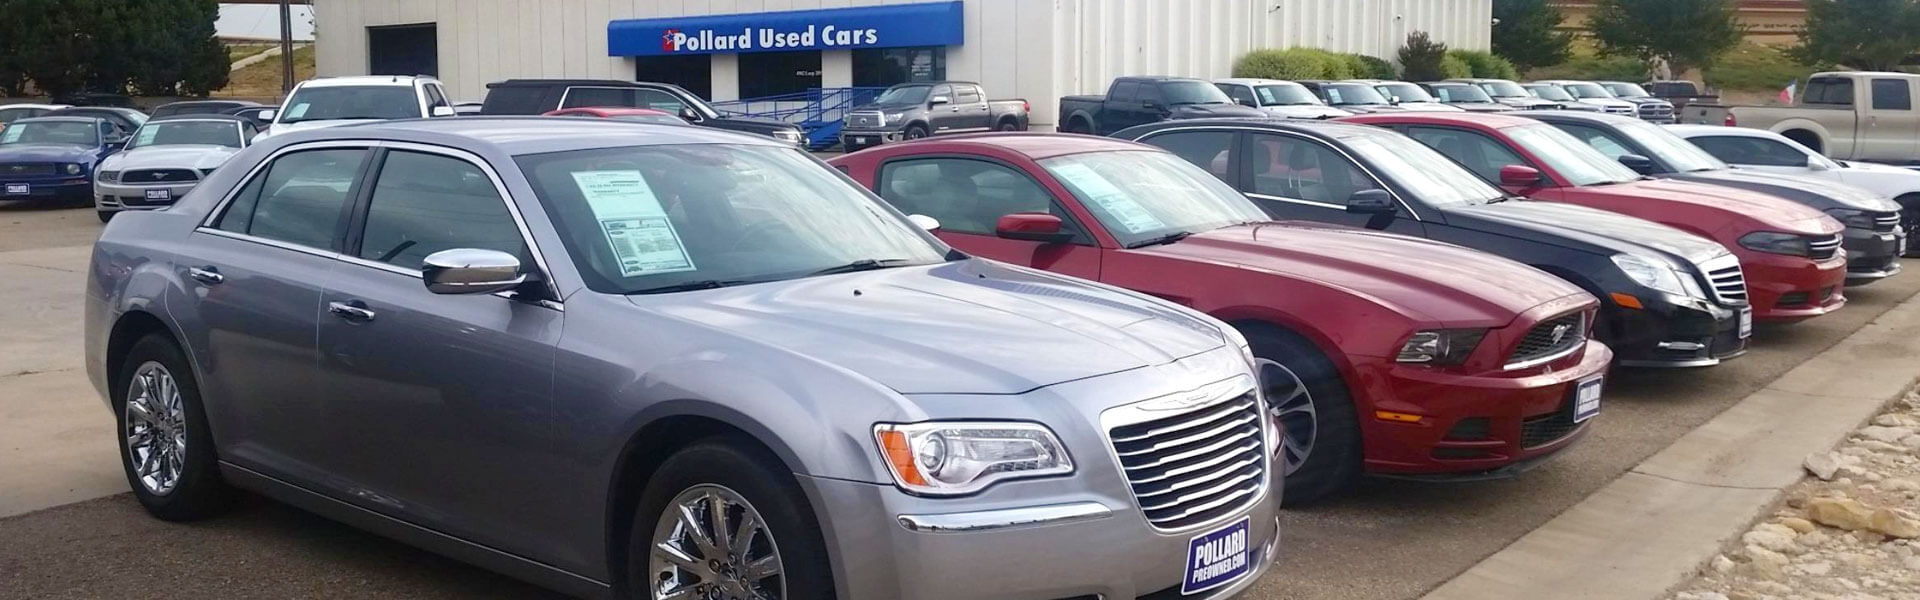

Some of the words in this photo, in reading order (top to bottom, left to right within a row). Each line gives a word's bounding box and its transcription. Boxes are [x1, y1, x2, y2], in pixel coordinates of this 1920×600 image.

[674, 28, 752, 51] Pollard
[759, 25, 815, 48] Used
[822, 25, 878, 45] Cars
[1194, 529, 1246, 569] POLLARD
[1192, 551, 1246, 584] PREOWNED.COM
